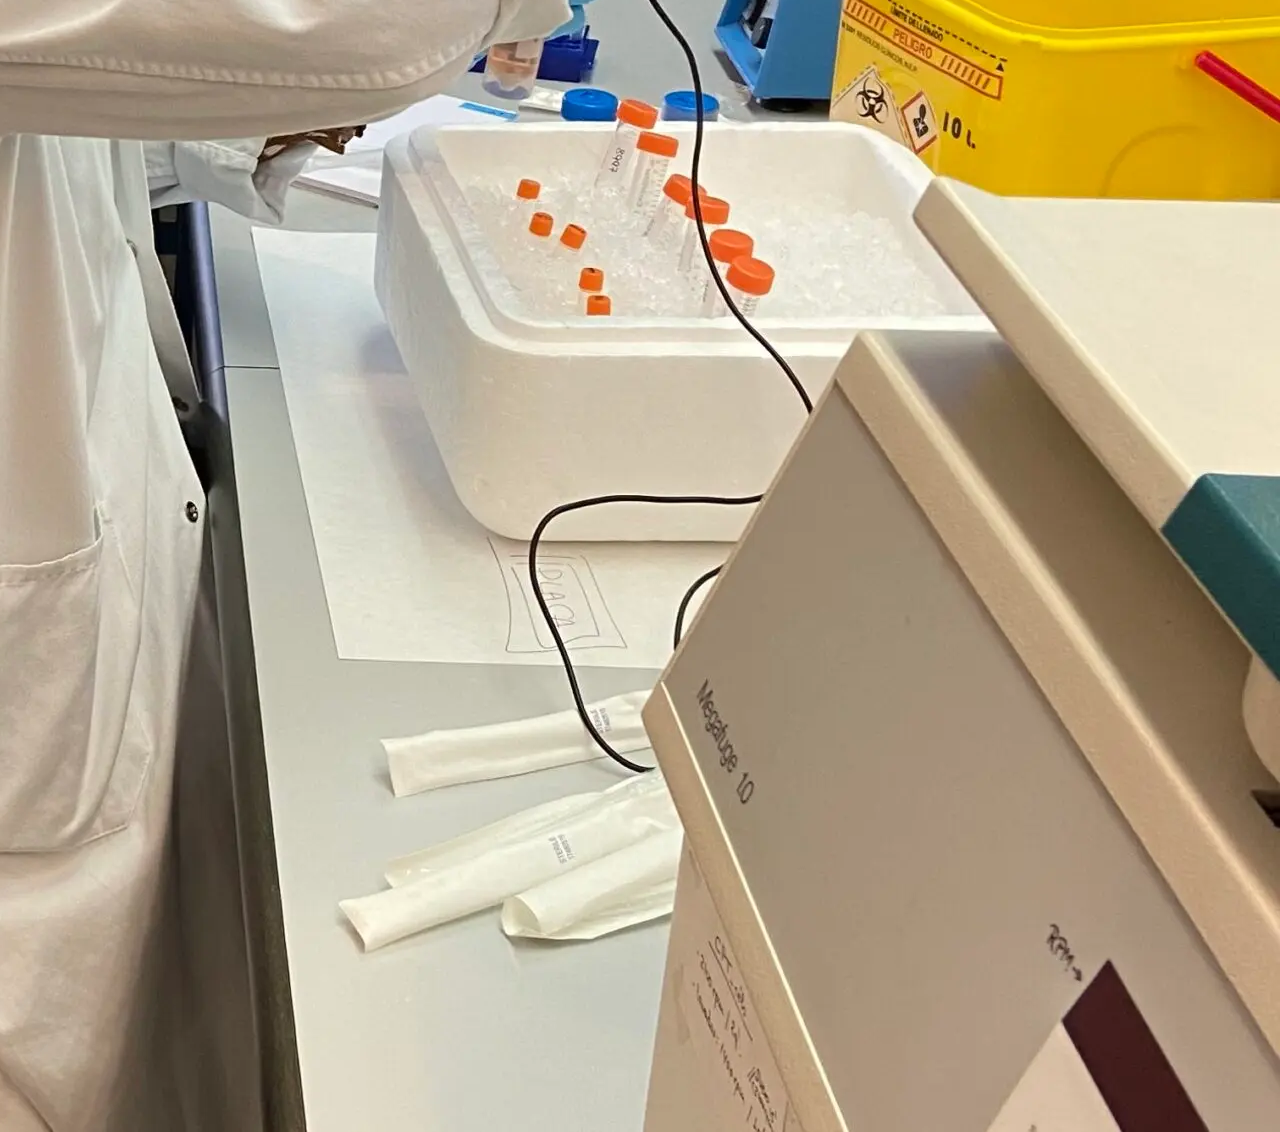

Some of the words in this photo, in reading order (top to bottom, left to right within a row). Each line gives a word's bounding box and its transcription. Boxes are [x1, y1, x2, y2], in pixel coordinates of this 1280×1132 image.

[892, 28, 933, 60] PELIGRO
[942, 111, 962, 139] 10
[696, 679, 739, 773] Megafuge
